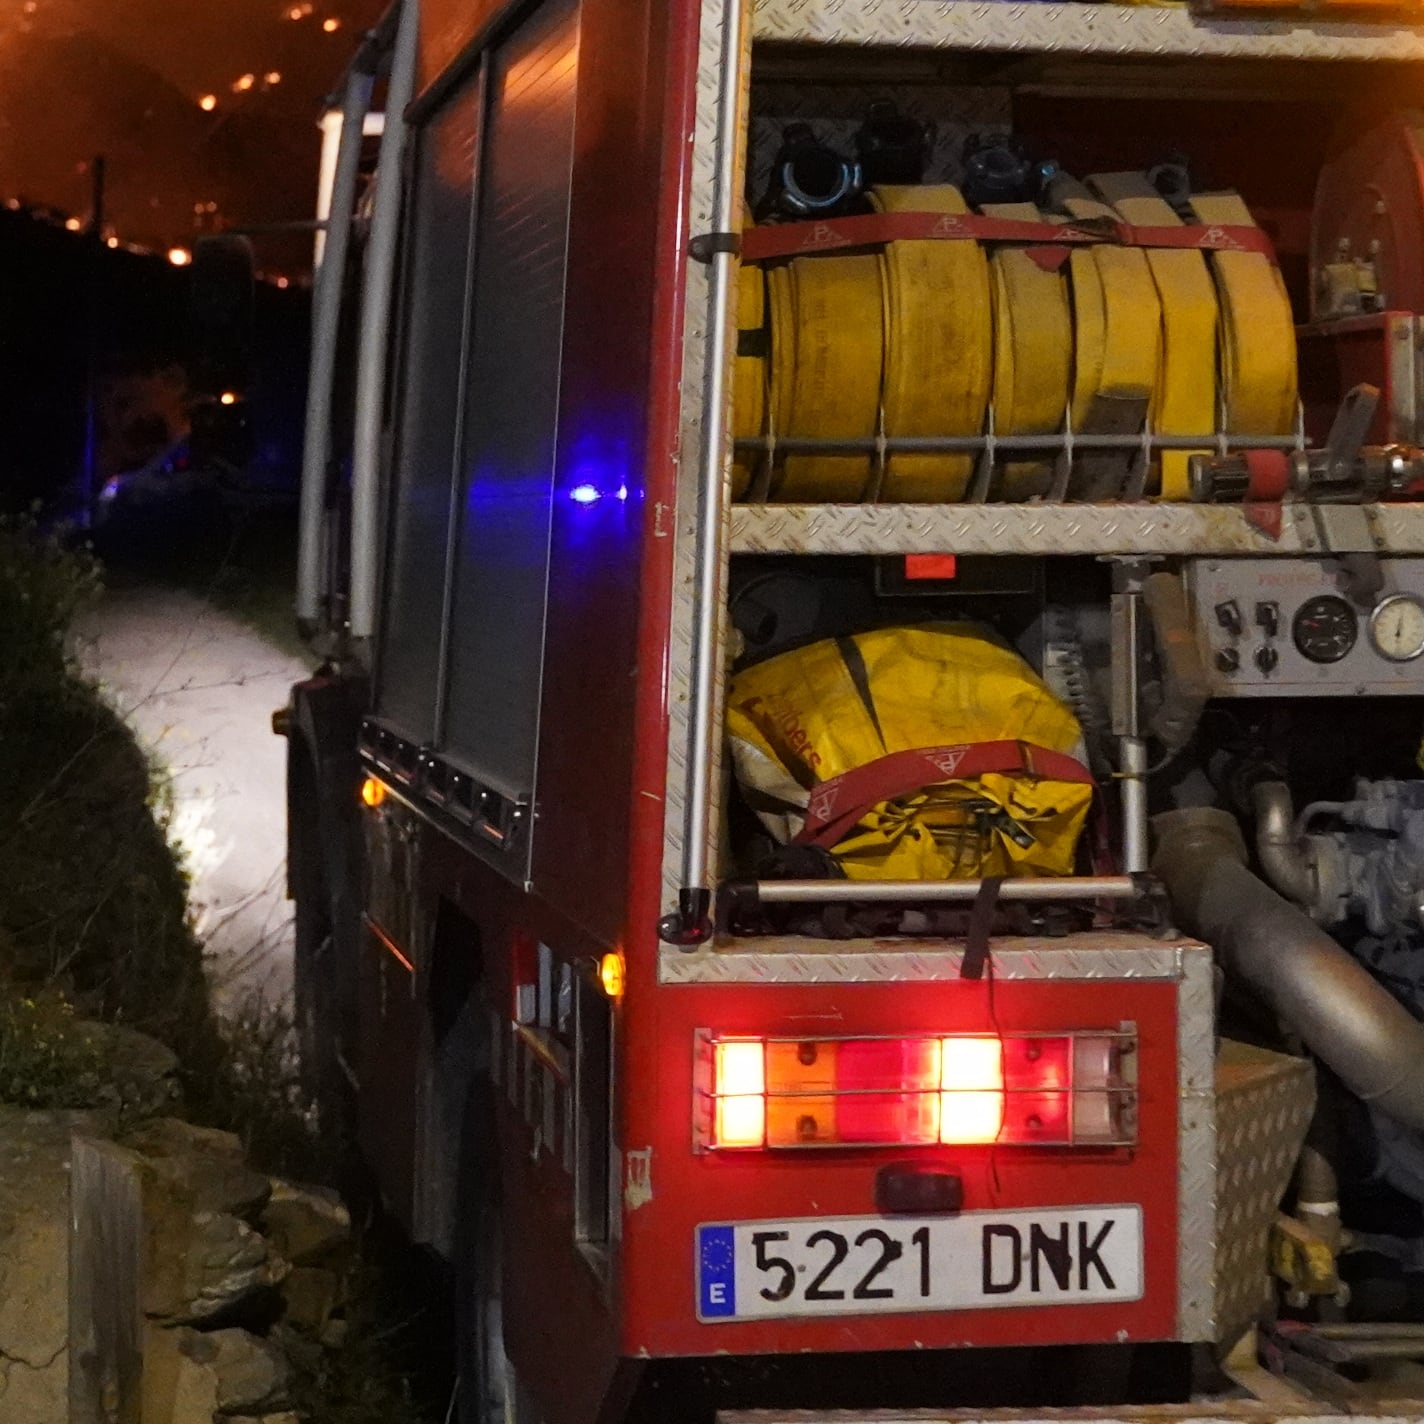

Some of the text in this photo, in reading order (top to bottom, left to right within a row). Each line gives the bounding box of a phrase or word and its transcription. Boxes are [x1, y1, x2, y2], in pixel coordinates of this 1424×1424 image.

[709, 1220, 1116, 1304] E 5221 DNK
